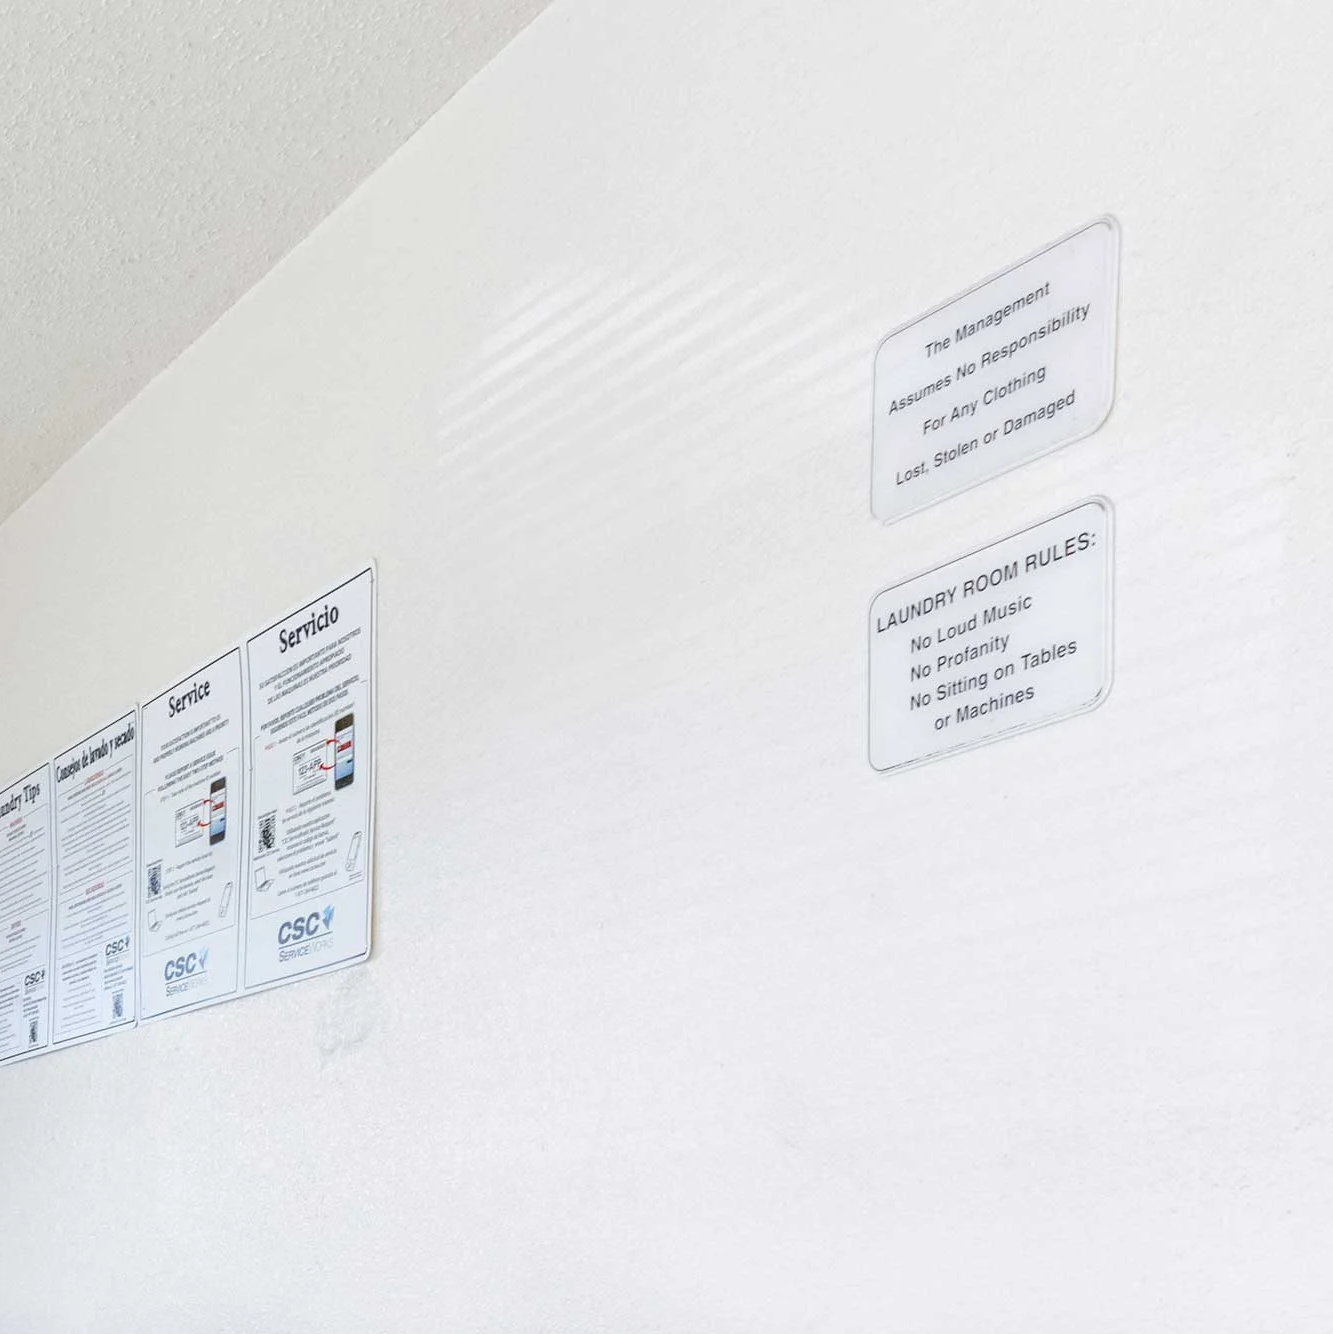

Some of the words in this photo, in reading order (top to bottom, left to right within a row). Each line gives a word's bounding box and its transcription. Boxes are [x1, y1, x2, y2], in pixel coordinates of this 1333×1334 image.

[925, 339, 951, 358] The
[955, 281, 1050, 344] Management
[889, 375, 951, 415] Assumes
[956, 363, 976, 381] No
[981, 303, 1090, 369] Responsibility
[922, 414, 946, 435] For
[950, 400, 977, 422] Any
[983, 366, 1046, 405] Clothing
[934, 439, 978, 468] Stolen
[983, 427, 998, 445] or
[1004, 390, 1076, 435] Damaged
[877, 586, 957, 633] LAUNDRY
[963, 561, 1018, 599] ROOM
[1025, 531, 1096, 573] RULES:
[279, 603, 339, 653] Servicio
[911, 635, 931, 653] No
[937, 617, 977, 644] Loud
[983, 595, 1032, 625] Music
[910, 692, 931, 710] No
[936, 673, 987, 701] Sitting
[994, 662, 1014, 681] on
[1021, 640, 1077, 671] Tables
[911, 664, 931, 681] No
[937, 634, 1010, 672] Profanity
[168, 680, 211, 718] Service
[935, 713, 950, 730] or
[956, 686, 1035, 723] Machines
[56, 757, 81, 783] Consejos
[82, 750, 88, 769] de
[89, 738, 108, 766] lavado
[114, 723, 135, 749] secado
[23, 782, 41, 804] Tips
[105, 939, 124, 956] CSC
[278, 911, 320, 944] CSC
[24, 971, 41, 986] CSC
[164, 952, 196, 981] CSC
